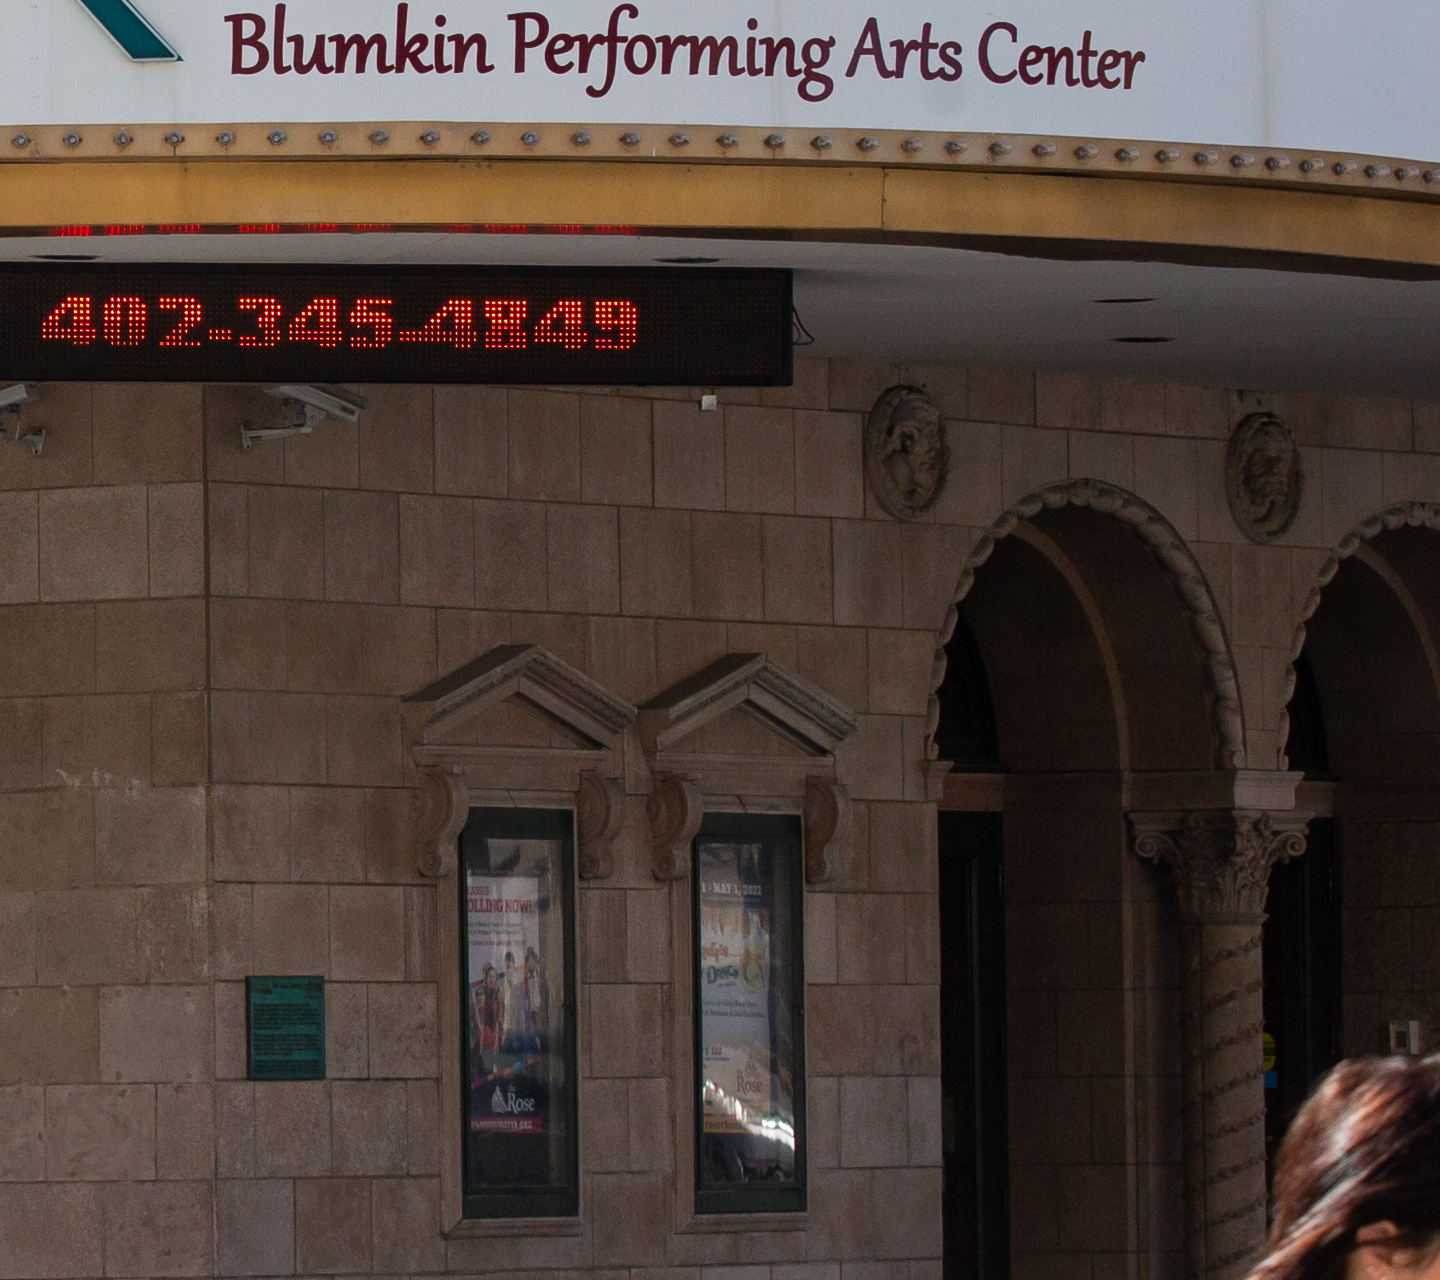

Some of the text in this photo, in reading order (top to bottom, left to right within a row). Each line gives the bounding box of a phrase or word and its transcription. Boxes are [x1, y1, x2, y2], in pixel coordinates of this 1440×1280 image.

[225, 1, 1145, 101] Blumkin Performing Arts Center
[41, 295, 639, 350] 402-345-4849
[743, 884, 763, 896] 2022
[468, 899, 532, 914] OLLING NOW!
[736, 1075, 763, 1094] Rose
[507, 1092, 535, 1114] Rose
